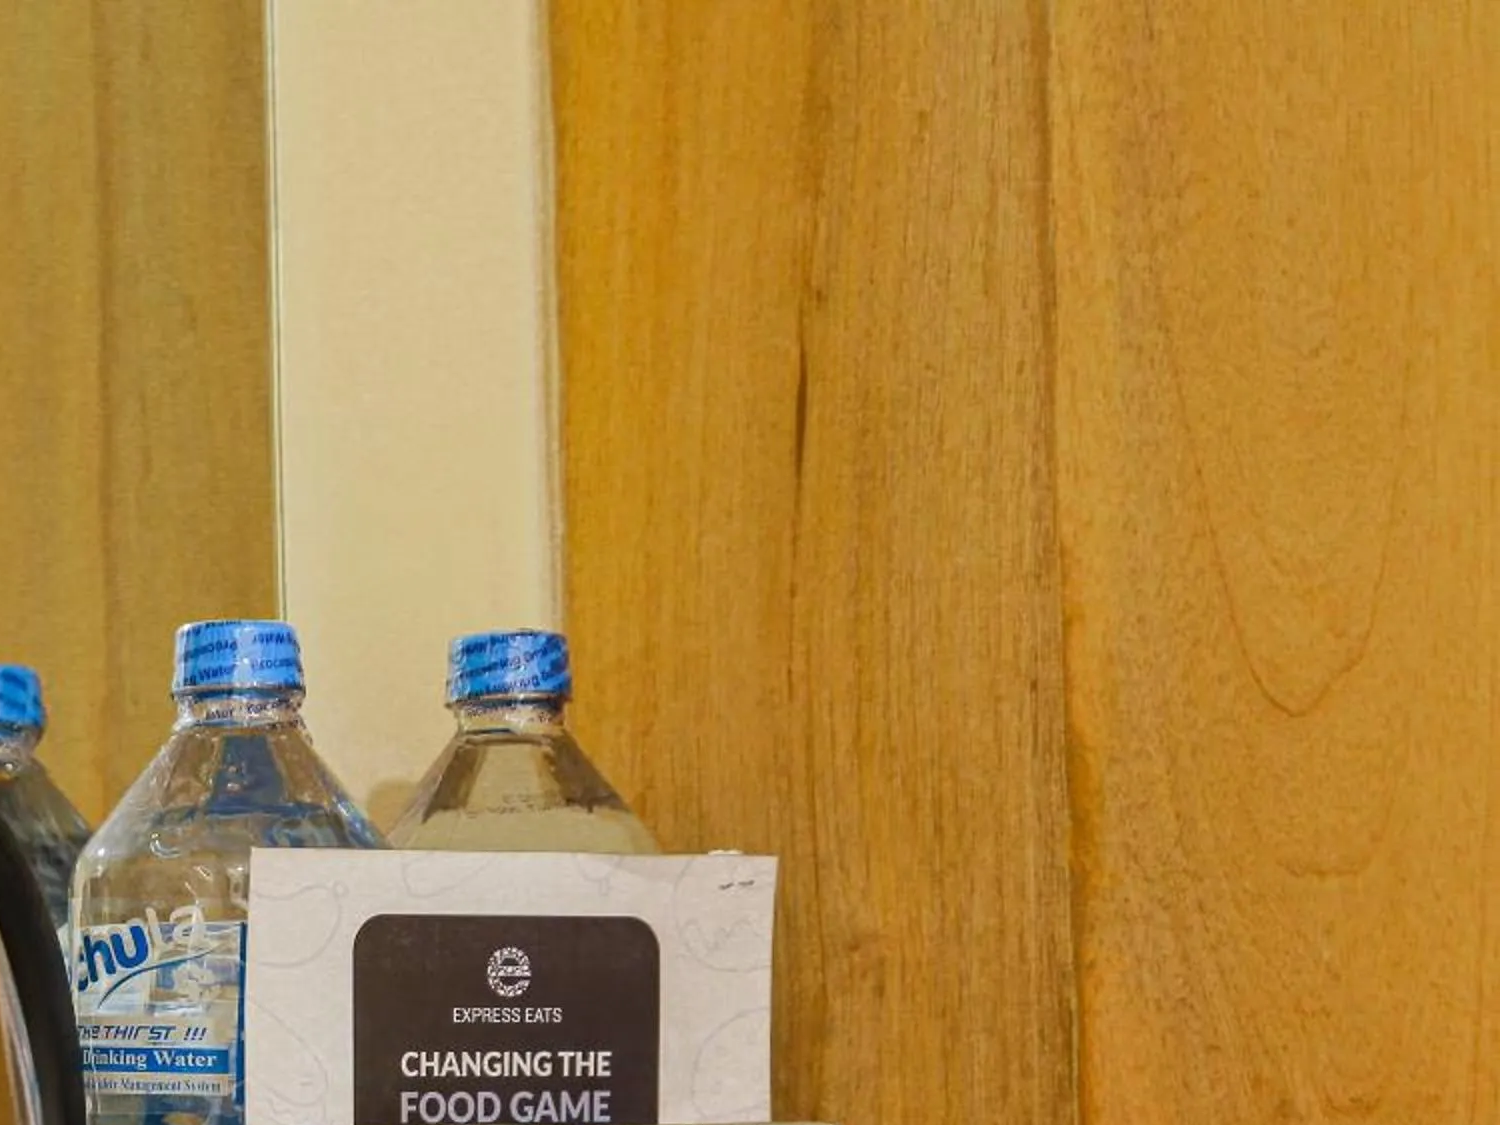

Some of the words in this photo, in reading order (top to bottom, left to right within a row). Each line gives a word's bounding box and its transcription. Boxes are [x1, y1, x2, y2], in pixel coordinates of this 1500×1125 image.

[452, 1007, 521, 1023] EXPRESS
[525, 1007, 563, 1023] EATS
[83, 1049, 147, 1069] Drinking
[152, 1050, 218, 1068] Water
[401, 1051, 552, 1078] CHANGING
[557, 1051, 613, 1078] THE
[400, 1090, 501, 1124] FOOD
[509, 1090, 612, 1124] GAME
